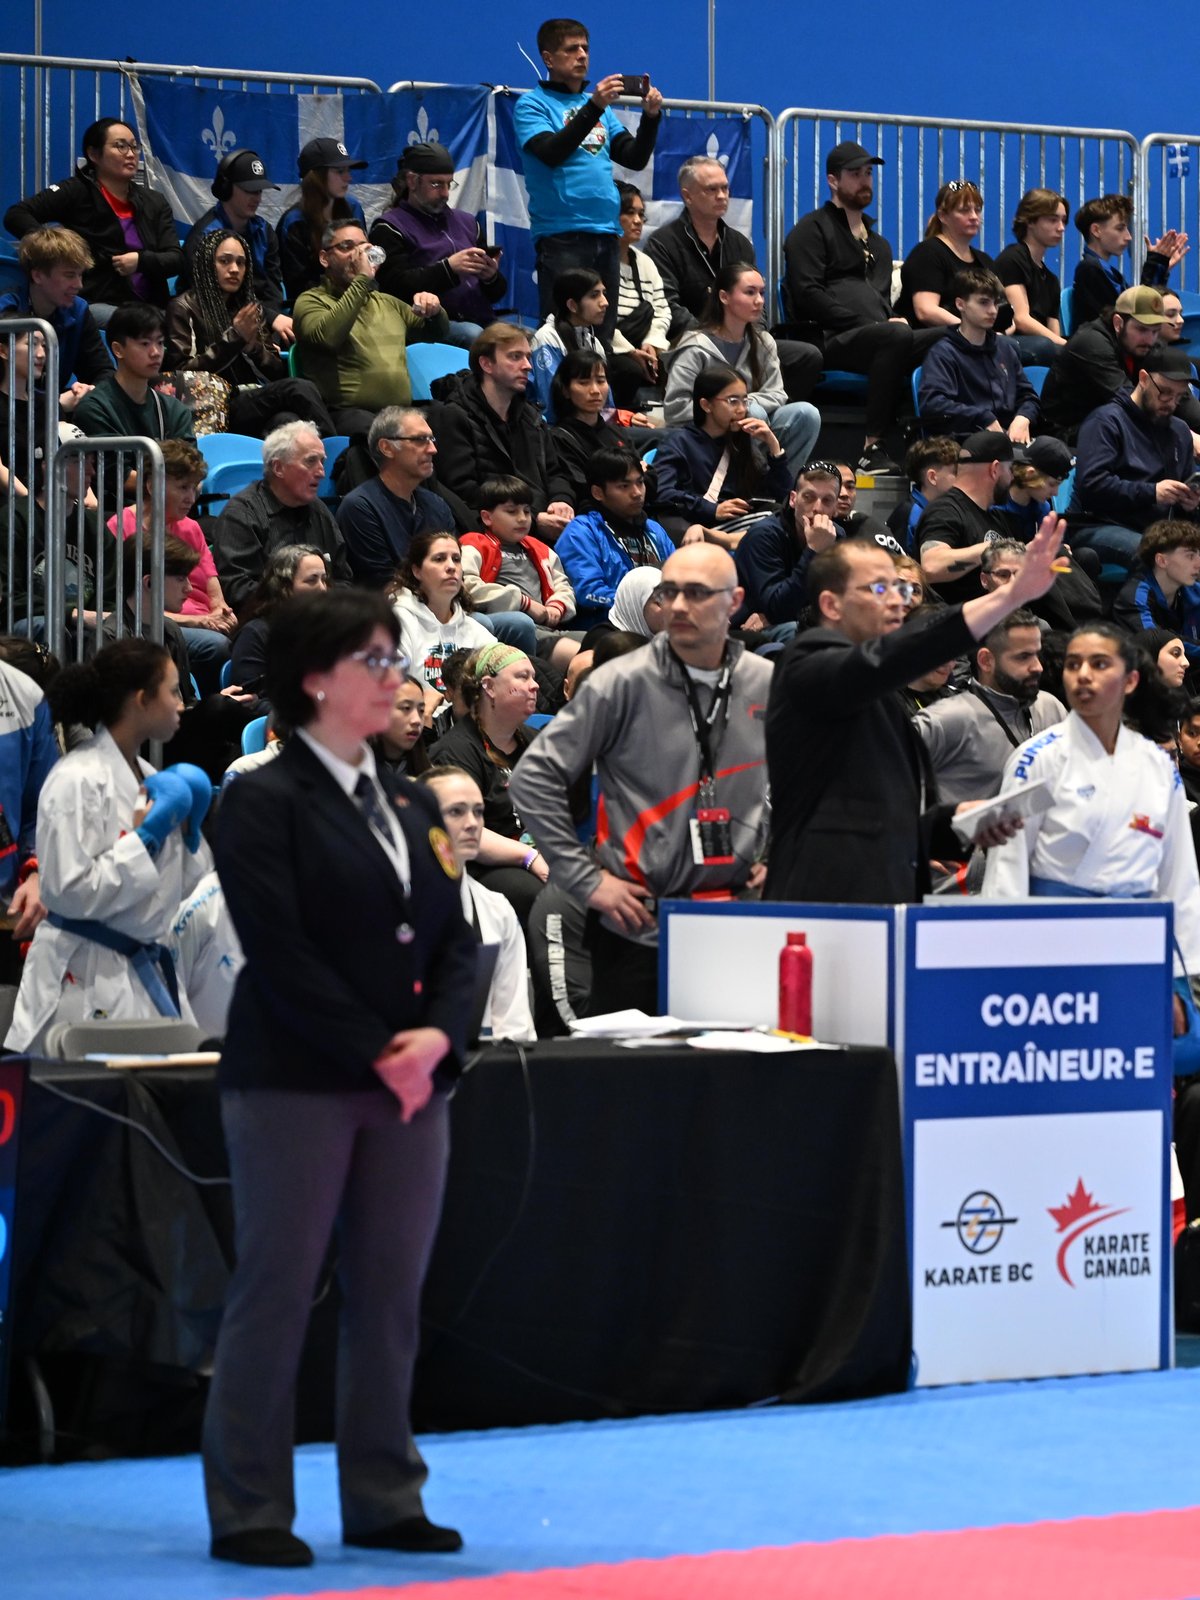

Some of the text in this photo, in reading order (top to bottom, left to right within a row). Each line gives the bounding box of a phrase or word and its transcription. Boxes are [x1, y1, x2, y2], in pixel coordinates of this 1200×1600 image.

[981, 992, 1099, 1026] COACH
[1084, 1233, 1150, 1255] KARATE
[924, 1263, 1033, 1287] KARATE BC
[1084, 1256, 1151, 1279] CANADA
